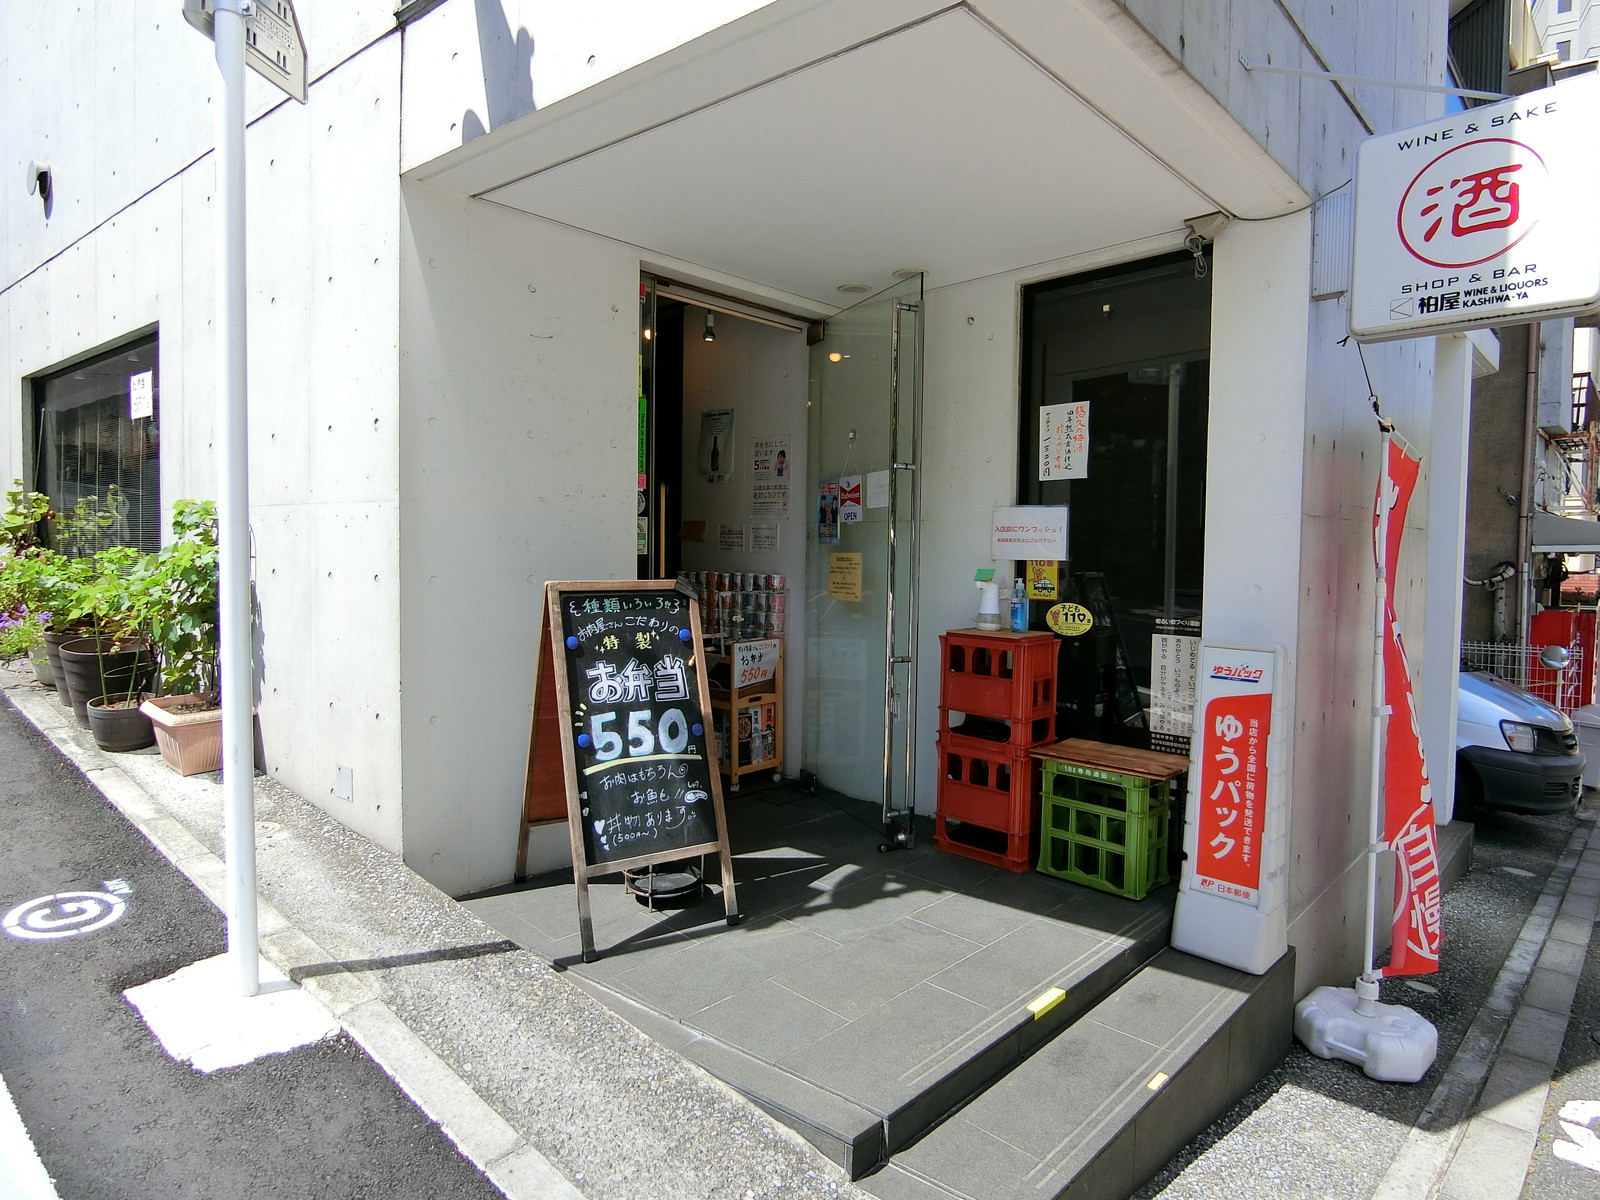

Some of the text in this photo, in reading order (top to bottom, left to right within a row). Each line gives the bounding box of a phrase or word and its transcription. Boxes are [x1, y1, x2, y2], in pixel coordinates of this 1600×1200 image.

[1397, 101, 1557, 151] WINE & SAKE
[1420, 163, 1523, 243] 酒
[1401, 263, 1537, 294] SHOP & BAR
[1463, 277, 1549, 297] WINE & LIQUORS
[1418, 291, 1461, 315] 柏屋
[1462, 292, 1529, 309] KASHIWA-YA
[844, 512, 857, 521] OPEN
[1060, 604, 1081, 613] 子ども
[740, 652, 764, 666] お弁当
[586, 653, 690, 704] お弁当
[740, 666, 768, 684] 550円
[1212, 664, 1264, 680] ゆうパック
[1210, 714, 1243, 859] ゆうパック
[1242, 718, 1259, 868] 当店から全国に荷物を発送できます。
[1217, 884, 1251, 900] 日本郵便
